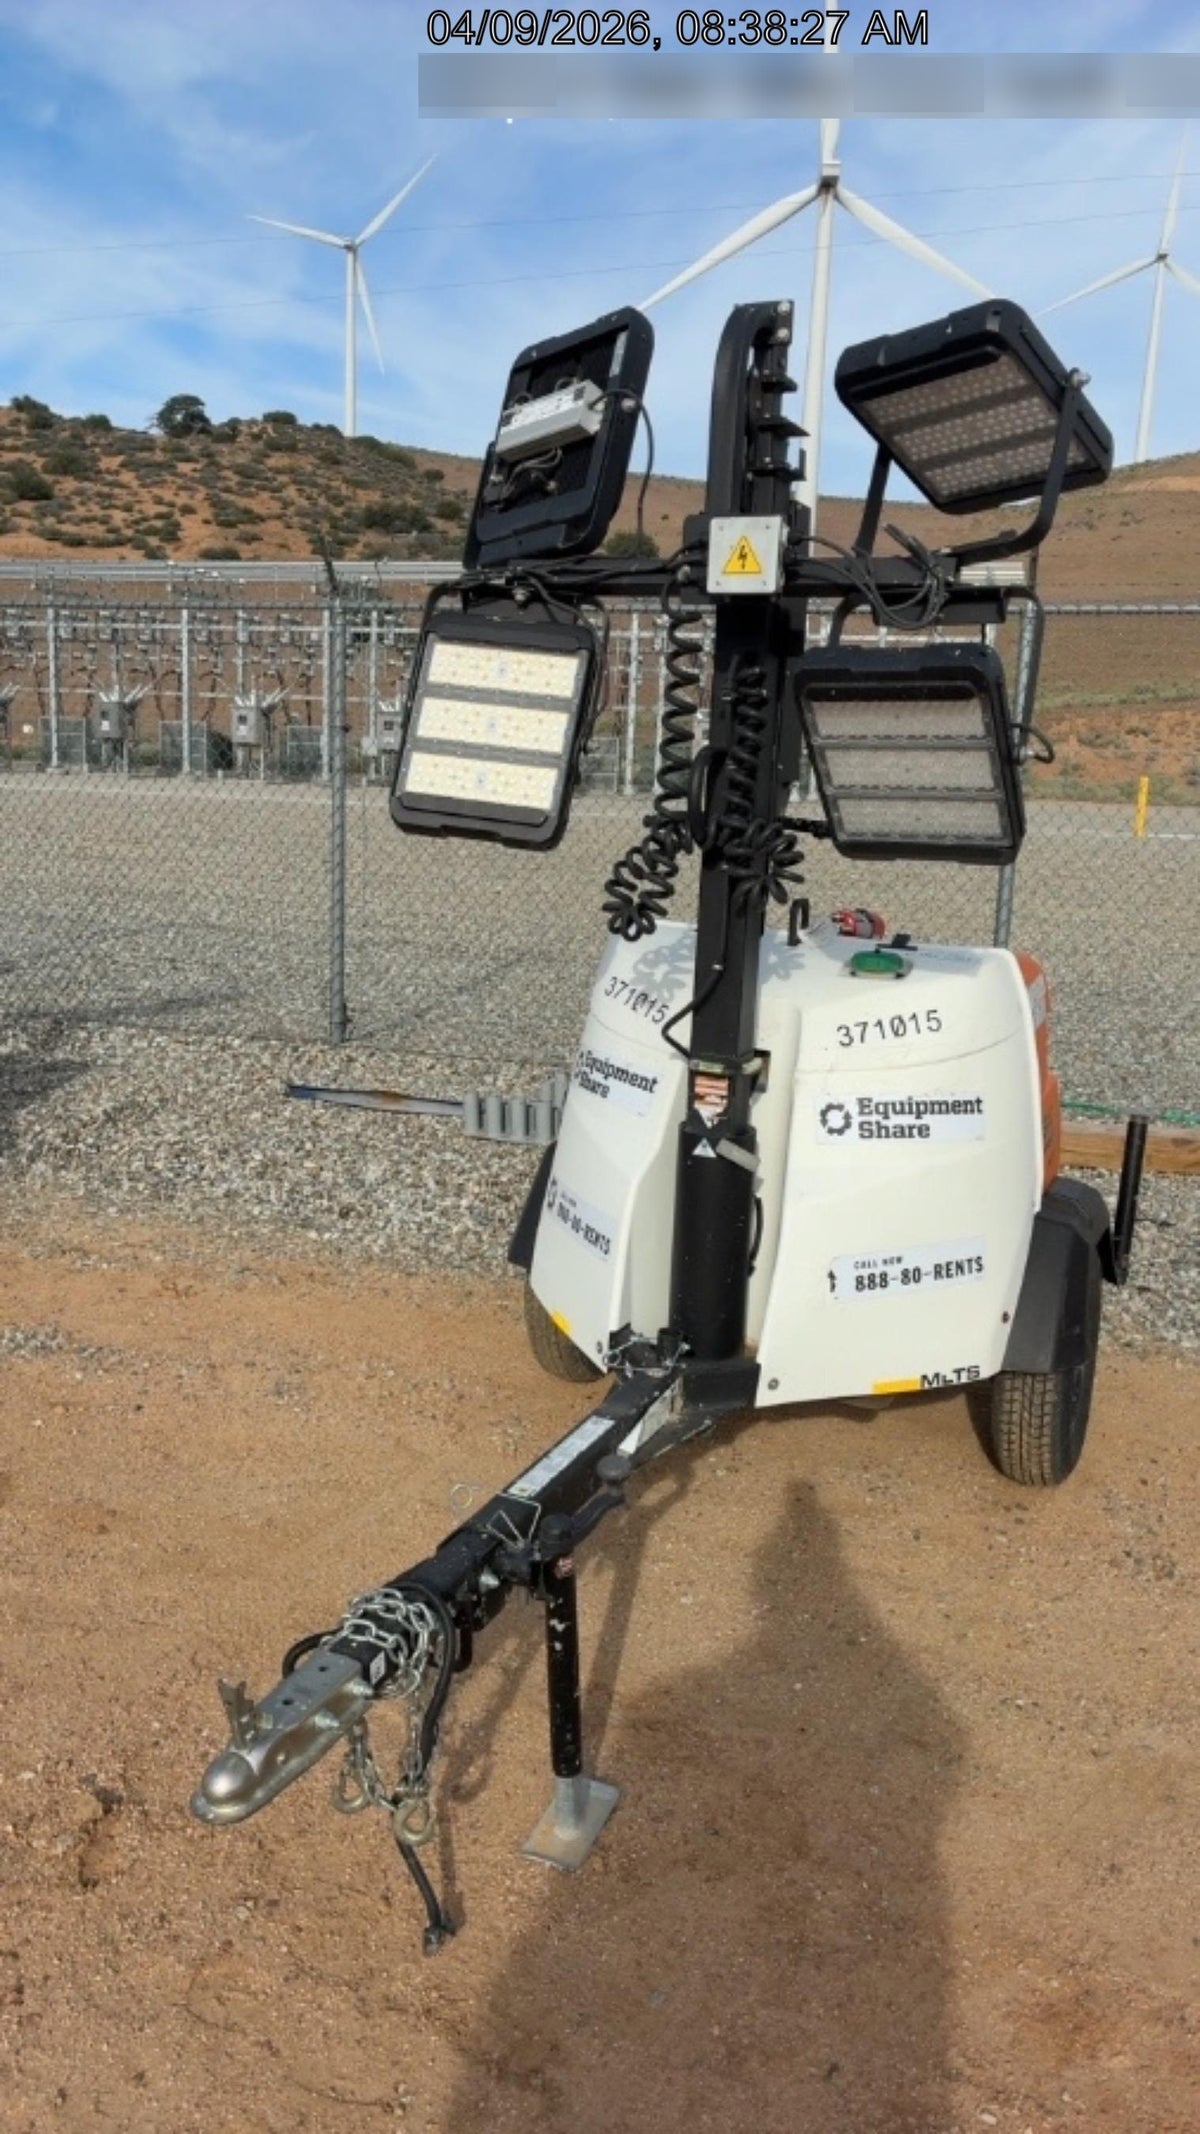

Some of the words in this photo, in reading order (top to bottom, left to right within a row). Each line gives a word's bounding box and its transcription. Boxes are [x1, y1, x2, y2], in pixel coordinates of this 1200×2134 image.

[604, 976, 669, 1024] 371015
[837, 1009, 942, 1047] 371015
[856, 1096, 983, 1119] Equipment
[858, 1120, 931, 1139] Share
[855, 1256, 984, 1292] 888-80-RENTS
